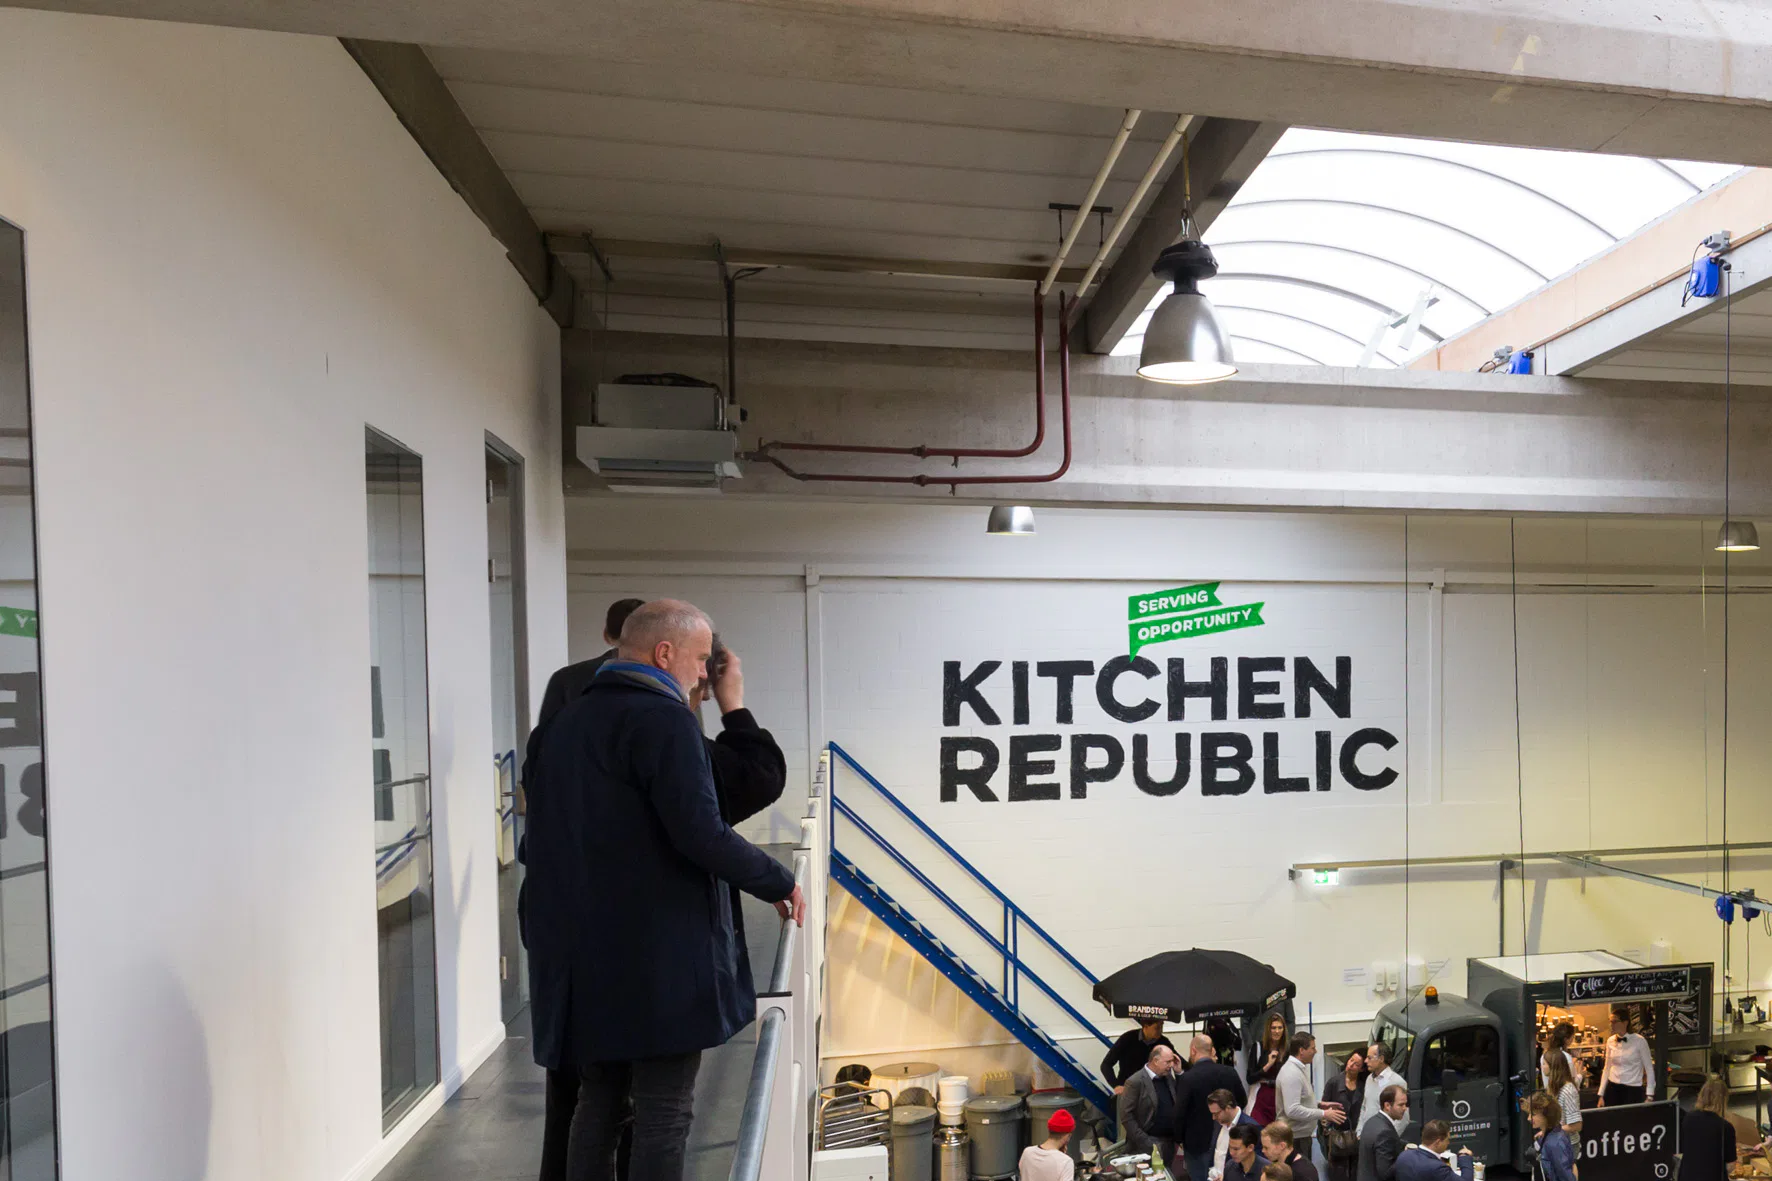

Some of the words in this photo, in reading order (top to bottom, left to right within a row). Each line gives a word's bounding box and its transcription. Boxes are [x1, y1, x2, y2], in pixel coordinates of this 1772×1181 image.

[1137, 589, 1209, 614] SERVING
[1137, 608, 1252, 641] OPPORTUNITY
[942, 654, 1351, 726] KITCHEN
[939, 727, 1399, 803] REPUBLIC
[1573, 977, 1604, 998] Coffee
[1128, 1005, 1168, 1015] BRANDSTOF
